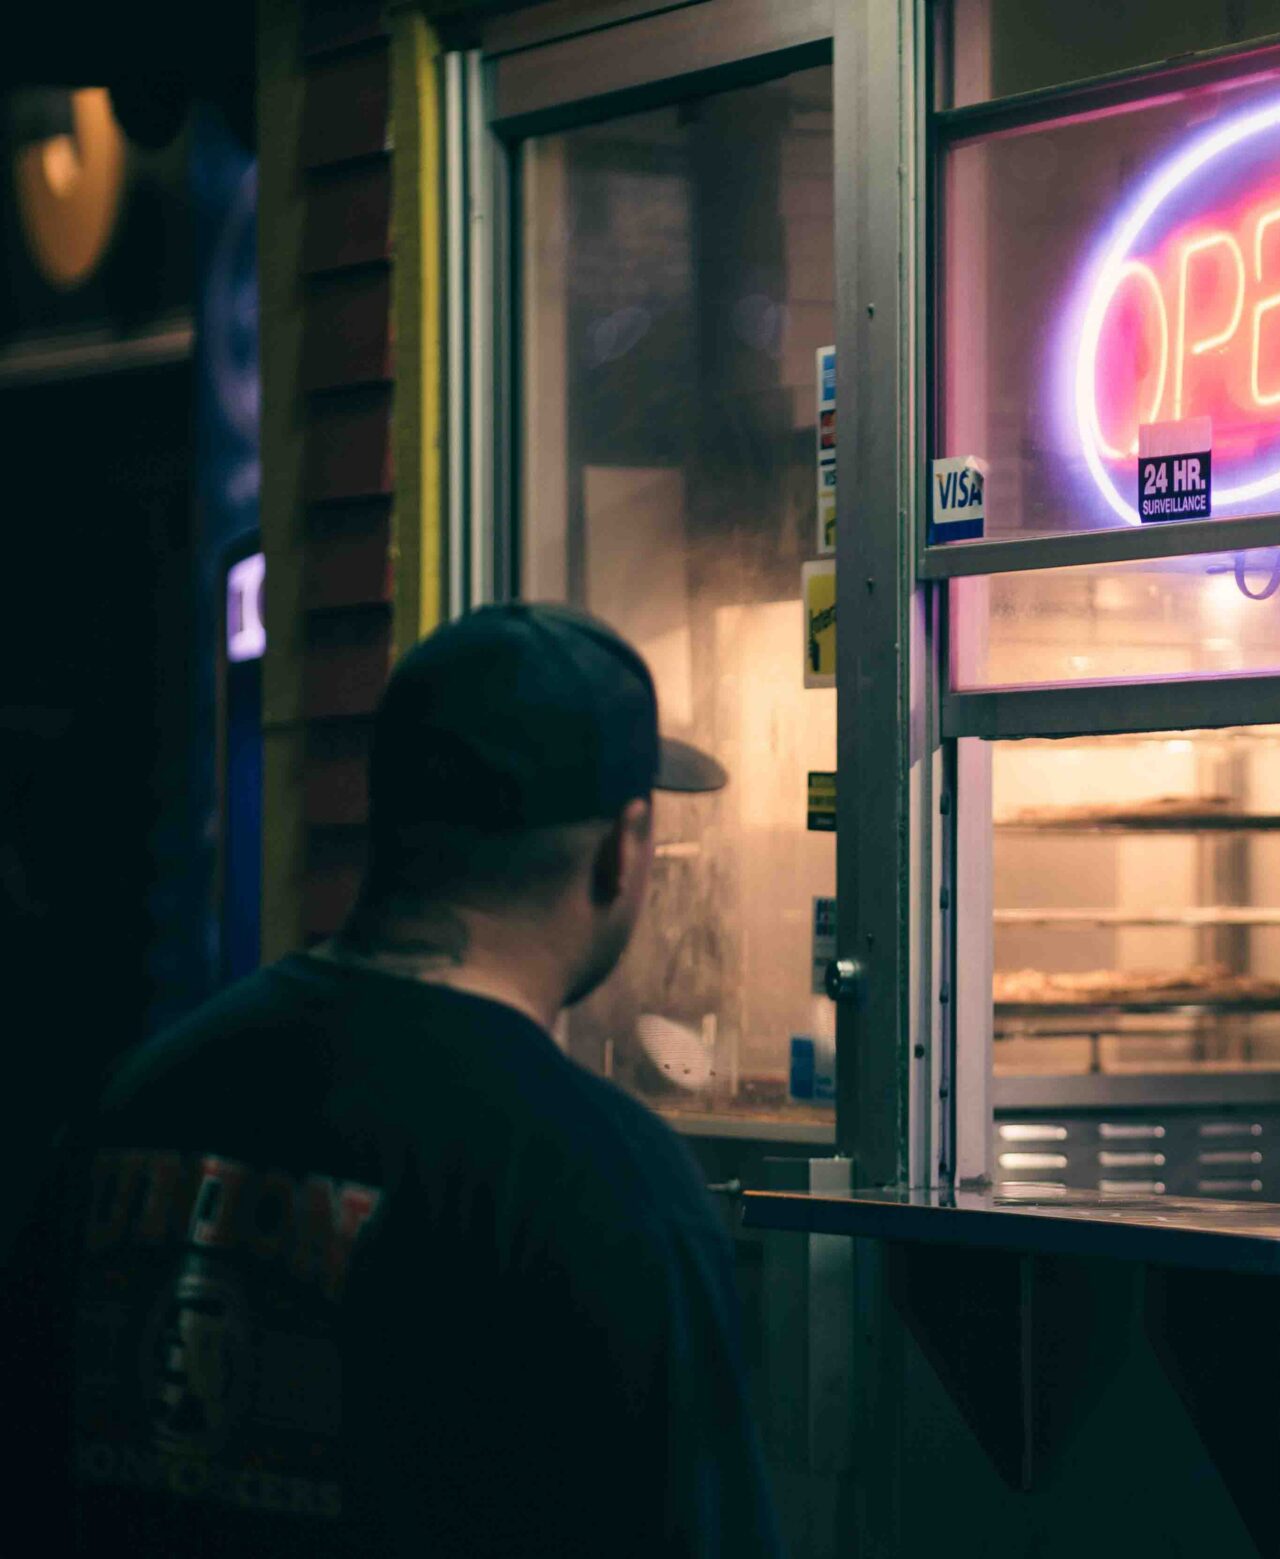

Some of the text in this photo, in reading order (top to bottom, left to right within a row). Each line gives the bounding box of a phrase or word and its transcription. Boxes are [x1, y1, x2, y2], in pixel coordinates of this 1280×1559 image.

[936, 467, 983, 510] VISA
[1144, 458, 1206, 495] 24 HR.
[1142, 494, 1206, 516] SURVEILLANCE
